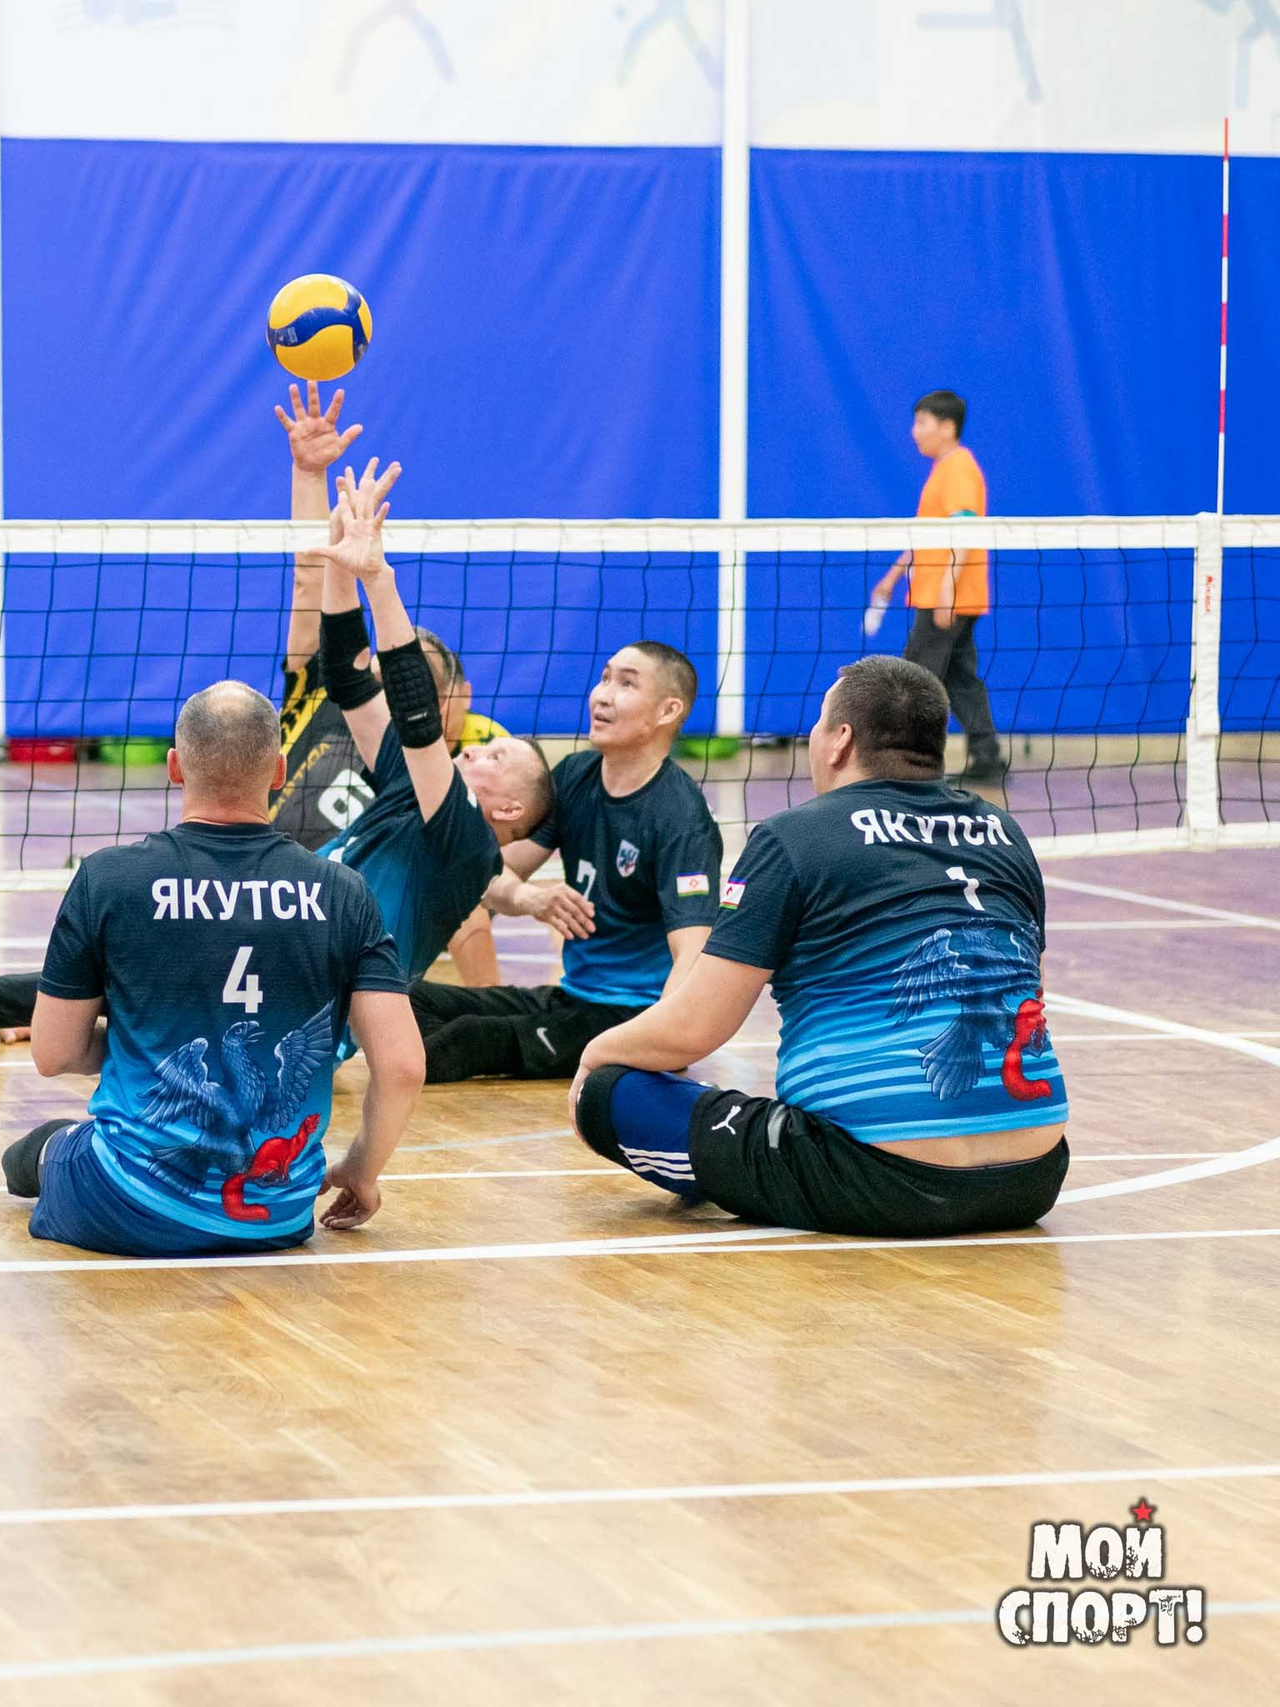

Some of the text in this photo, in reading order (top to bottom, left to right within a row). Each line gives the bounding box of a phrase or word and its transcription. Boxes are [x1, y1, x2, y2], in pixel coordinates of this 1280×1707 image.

[850, 808, 1013, 846] ЯКУТСК
[151, 878, 327, 921] ЯКУТСК
[222, 946, 263, 1013] 4
